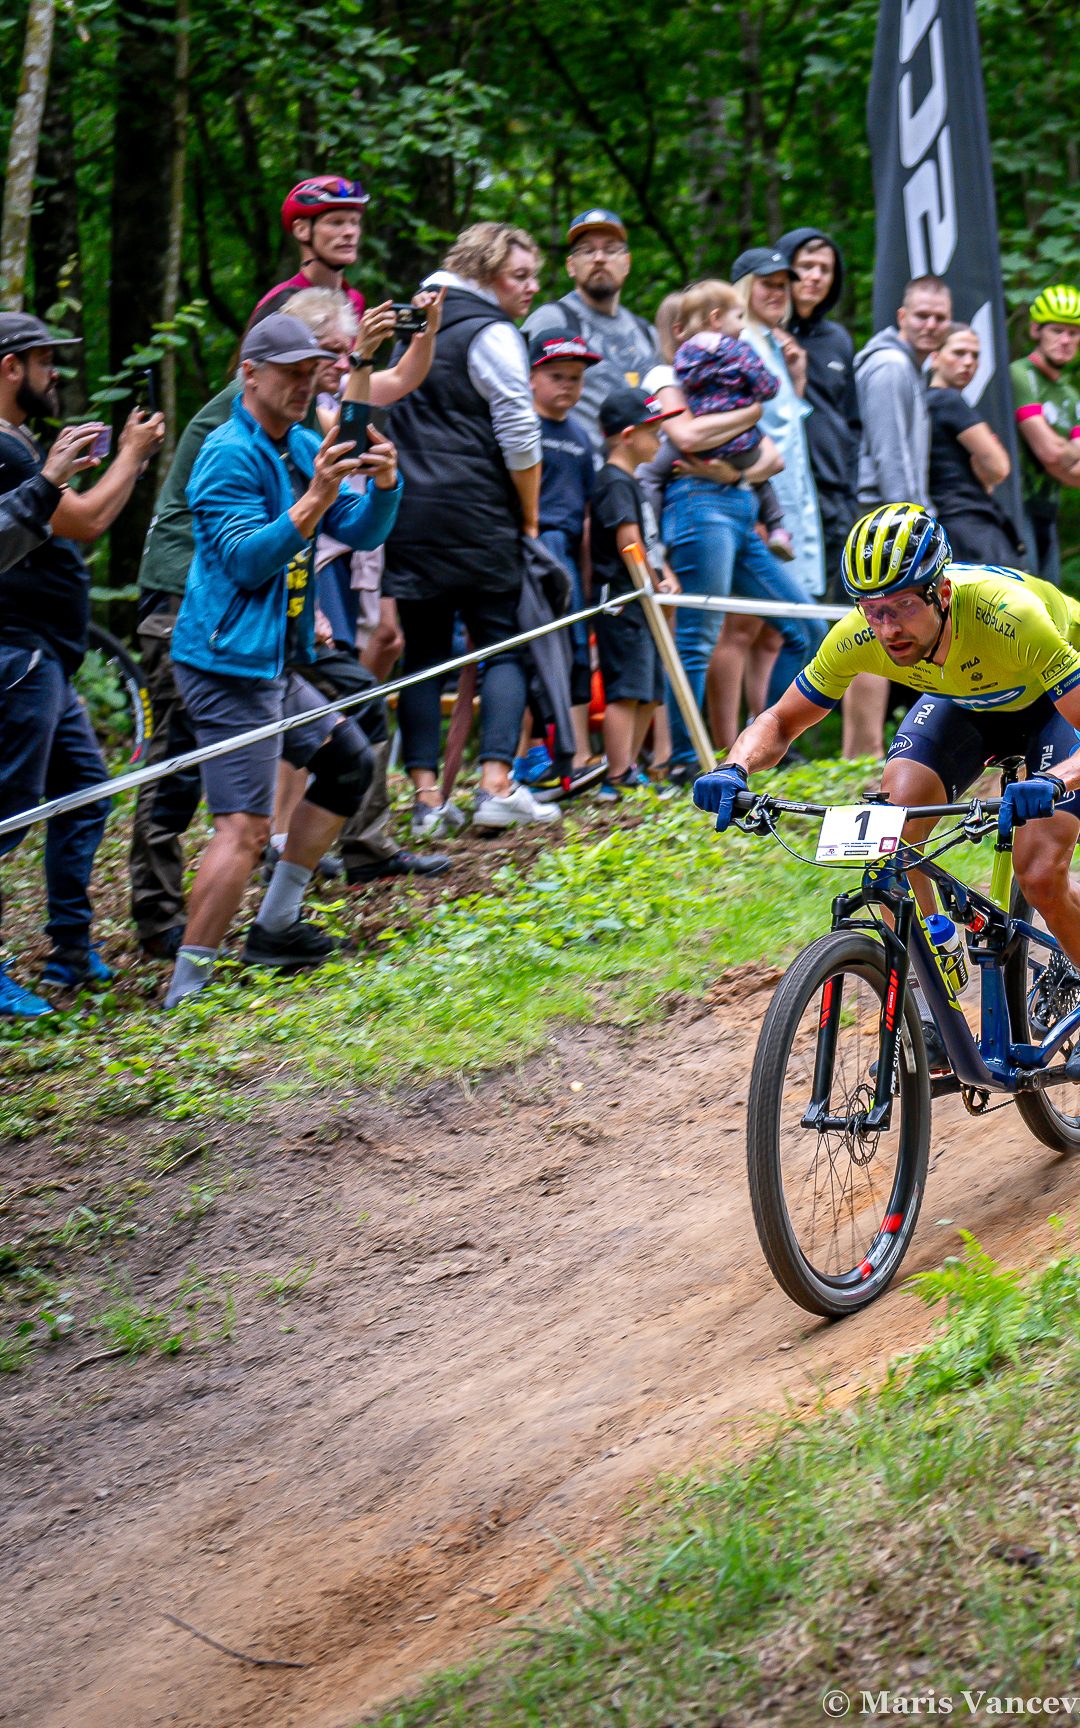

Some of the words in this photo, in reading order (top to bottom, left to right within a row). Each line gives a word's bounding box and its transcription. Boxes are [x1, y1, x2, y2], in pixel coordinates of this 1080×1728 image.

[975, 606, 1016, 640] EKOPLAZA
[960, 656, 980, 672] FILA
[913, 703, 936, 726] FILA
[1040, 744, 1054, 771] FILA
[855, 810, 871, 841] 1
